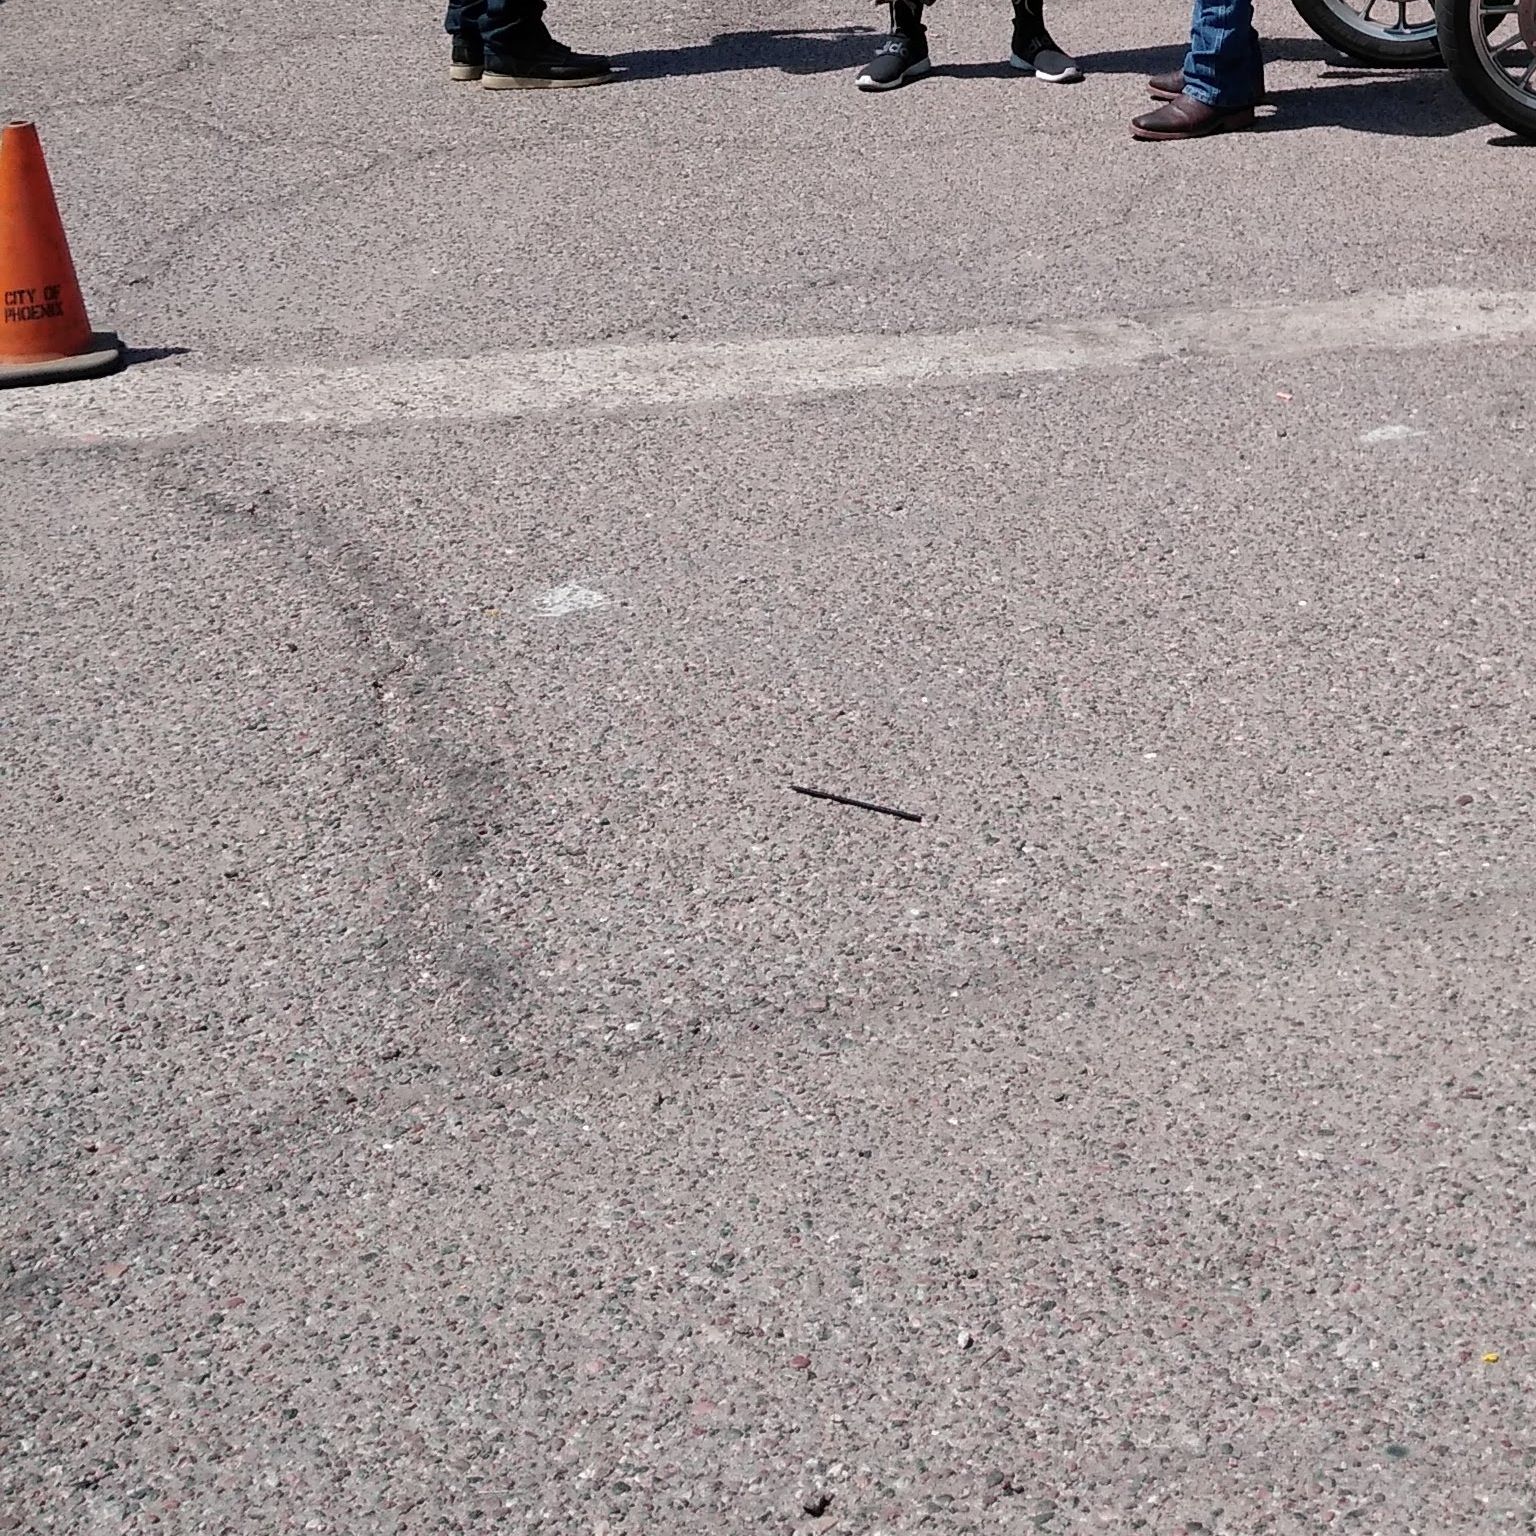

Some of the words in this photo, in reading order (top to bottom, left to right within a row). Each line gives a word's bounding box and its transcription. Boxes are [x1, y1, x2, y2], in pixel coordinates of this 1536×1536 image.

[4, 287, 37, 306] CITY
[43, 284, 61, 302] OF
[4, 301, 65, 323] PHOENIX
